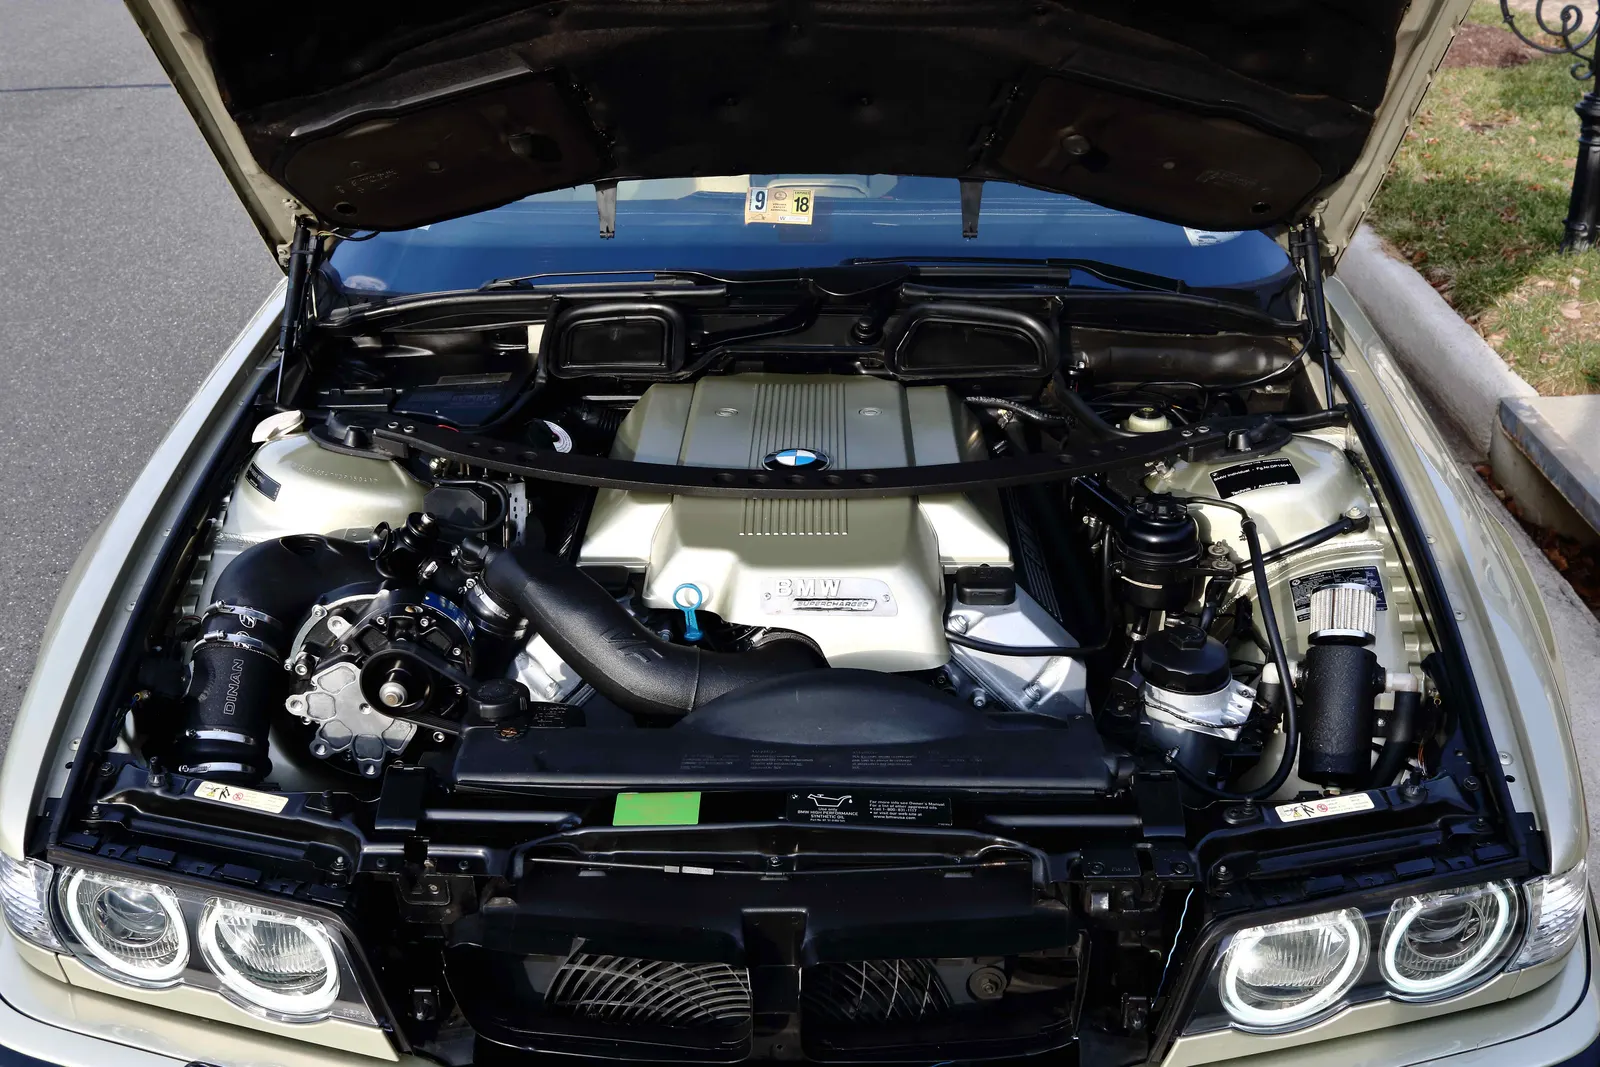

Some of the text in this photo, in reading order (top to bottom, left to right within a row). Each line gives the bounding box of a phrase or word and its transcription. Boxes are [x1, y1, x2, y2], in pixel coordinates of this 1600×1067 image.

[755, 191, 765, 210] 9
[794, 196, 809, 212] 18
[776, 578, 841, 598] BMW
[223, 658, 244, 716] DINAN
